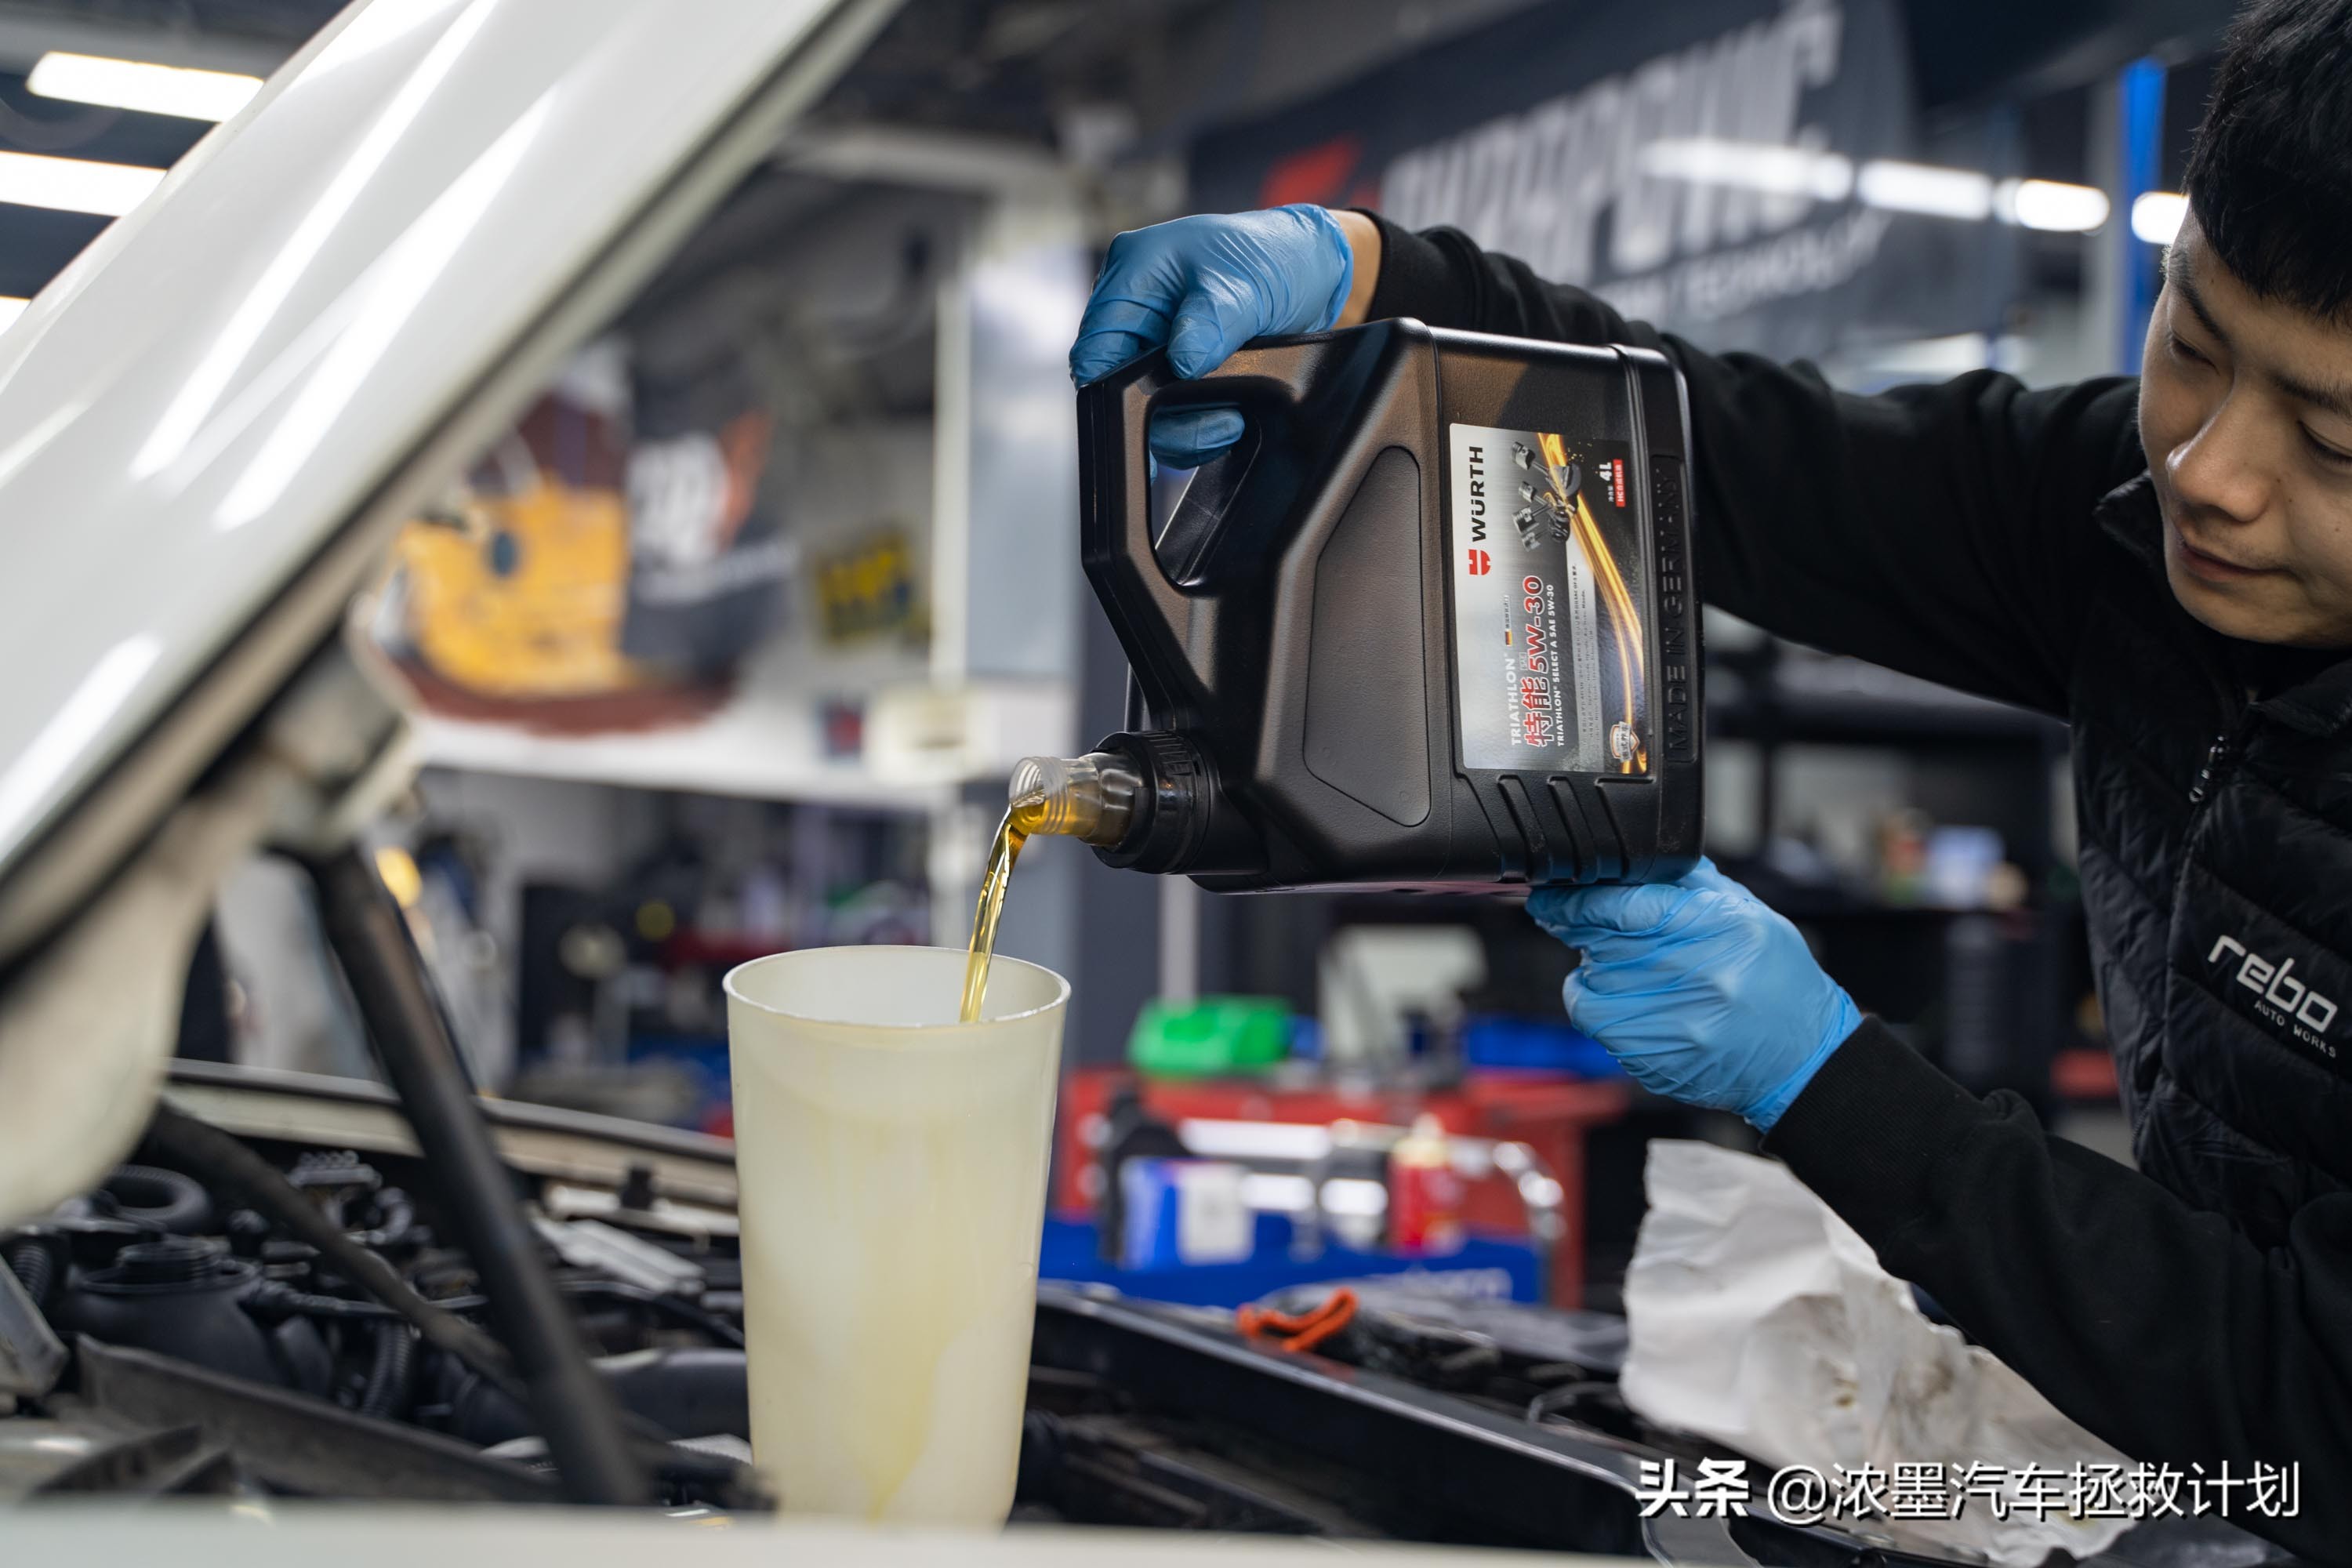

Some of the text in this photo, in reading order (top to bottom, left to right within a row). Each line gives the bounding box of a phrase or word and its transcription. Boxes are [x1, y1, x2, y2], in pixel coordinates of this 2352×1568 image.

[1469, 446, 1486, 543] WÜRTH
[1599, 462, 1612, 481] 4L
[1546, 584, 1556, 617] 5W-30
[1655, 468, 1687, 750] MADE IN GERMANY
[1548, 621, 1557, 638] SAE
[1550, 640, 1558, 648] A
[1519, 575, 1554, 747] 特能 5W-30
[1550, 650, 1560, 683] SELECT
[2207, 935, 2339, 1034] rebo
[2253, 1000, 2337, 1059] AUTO WORKS
